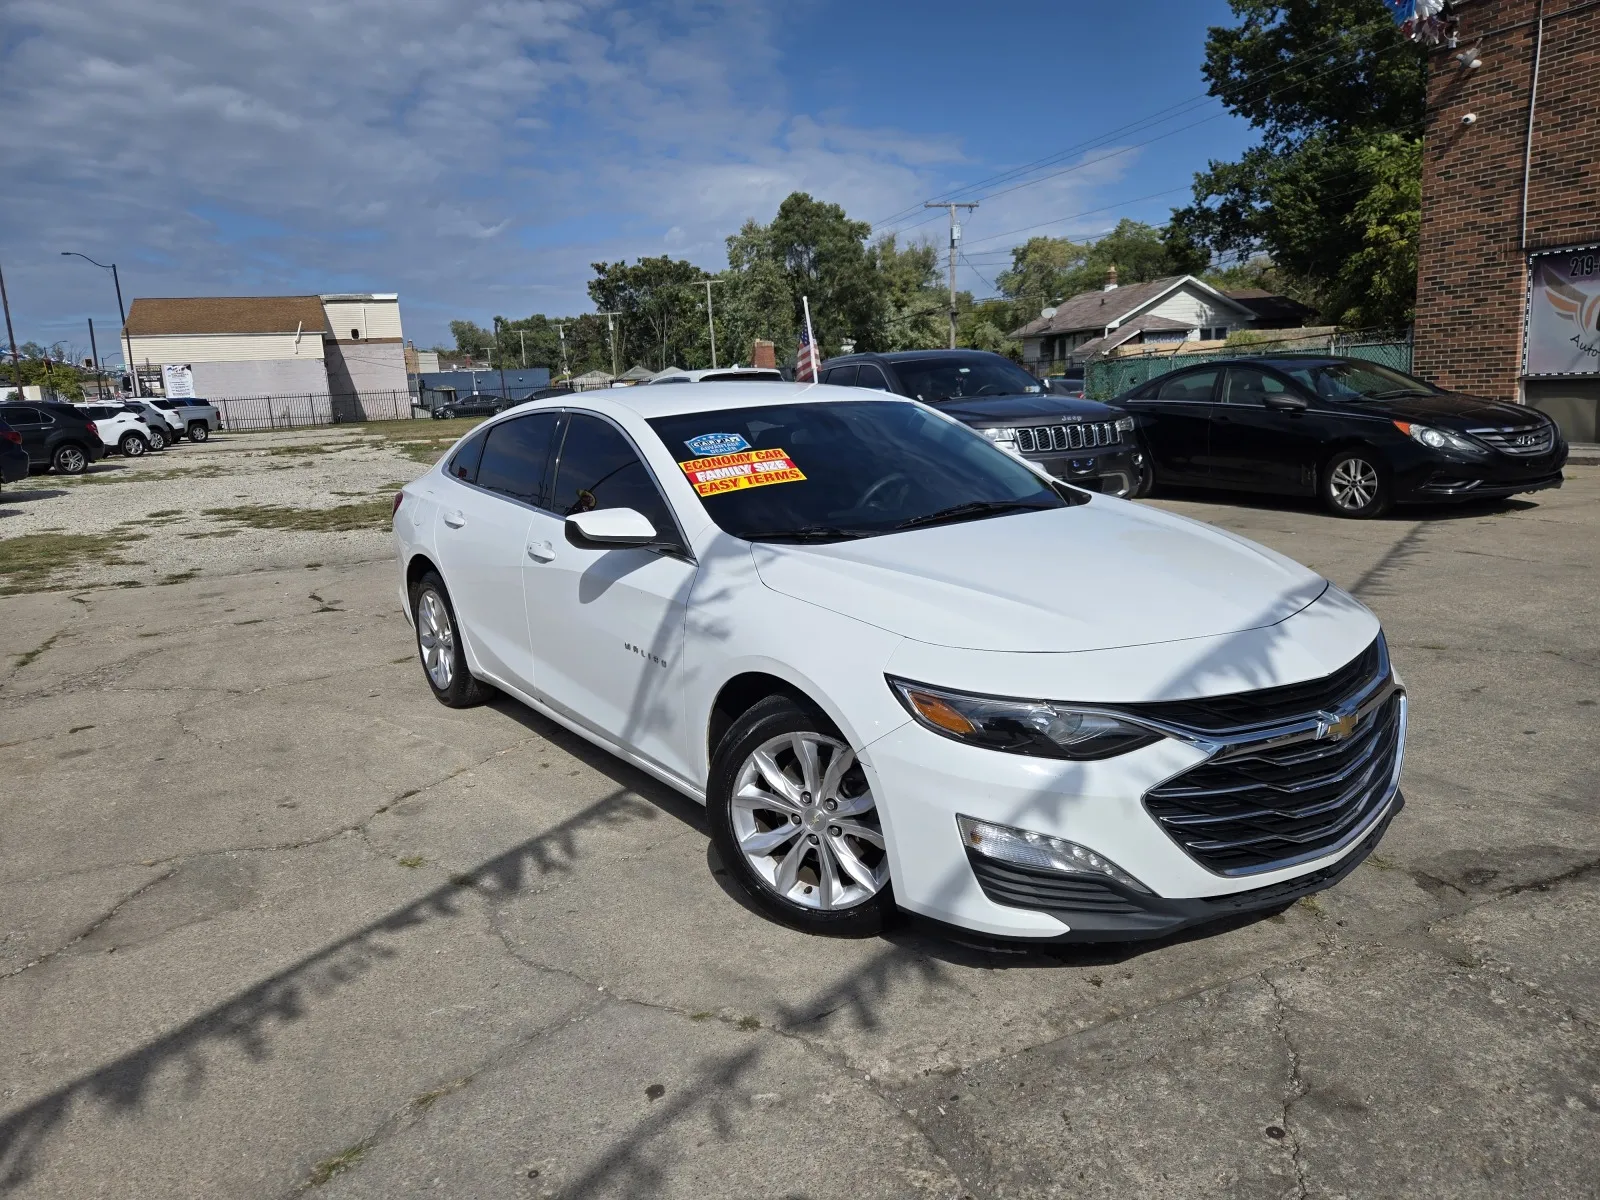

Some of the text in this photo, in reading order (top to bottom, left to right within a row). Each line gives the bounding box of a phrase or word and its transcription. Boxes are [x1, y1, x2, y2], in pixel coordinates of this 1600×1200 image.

[1570, 255, 1600, 276] 219-
[700, 442, 740, 451] ADVANTAGE
[710, 446, 737, 454] DEALER
[684, 450, 784, 471] ECONOMY CAR
[695, 460, 788, 482] FAMILY SIZE
[698, 470, 799, 494] EASY TERMS
[624, 642, 667, 668] MALIBU
